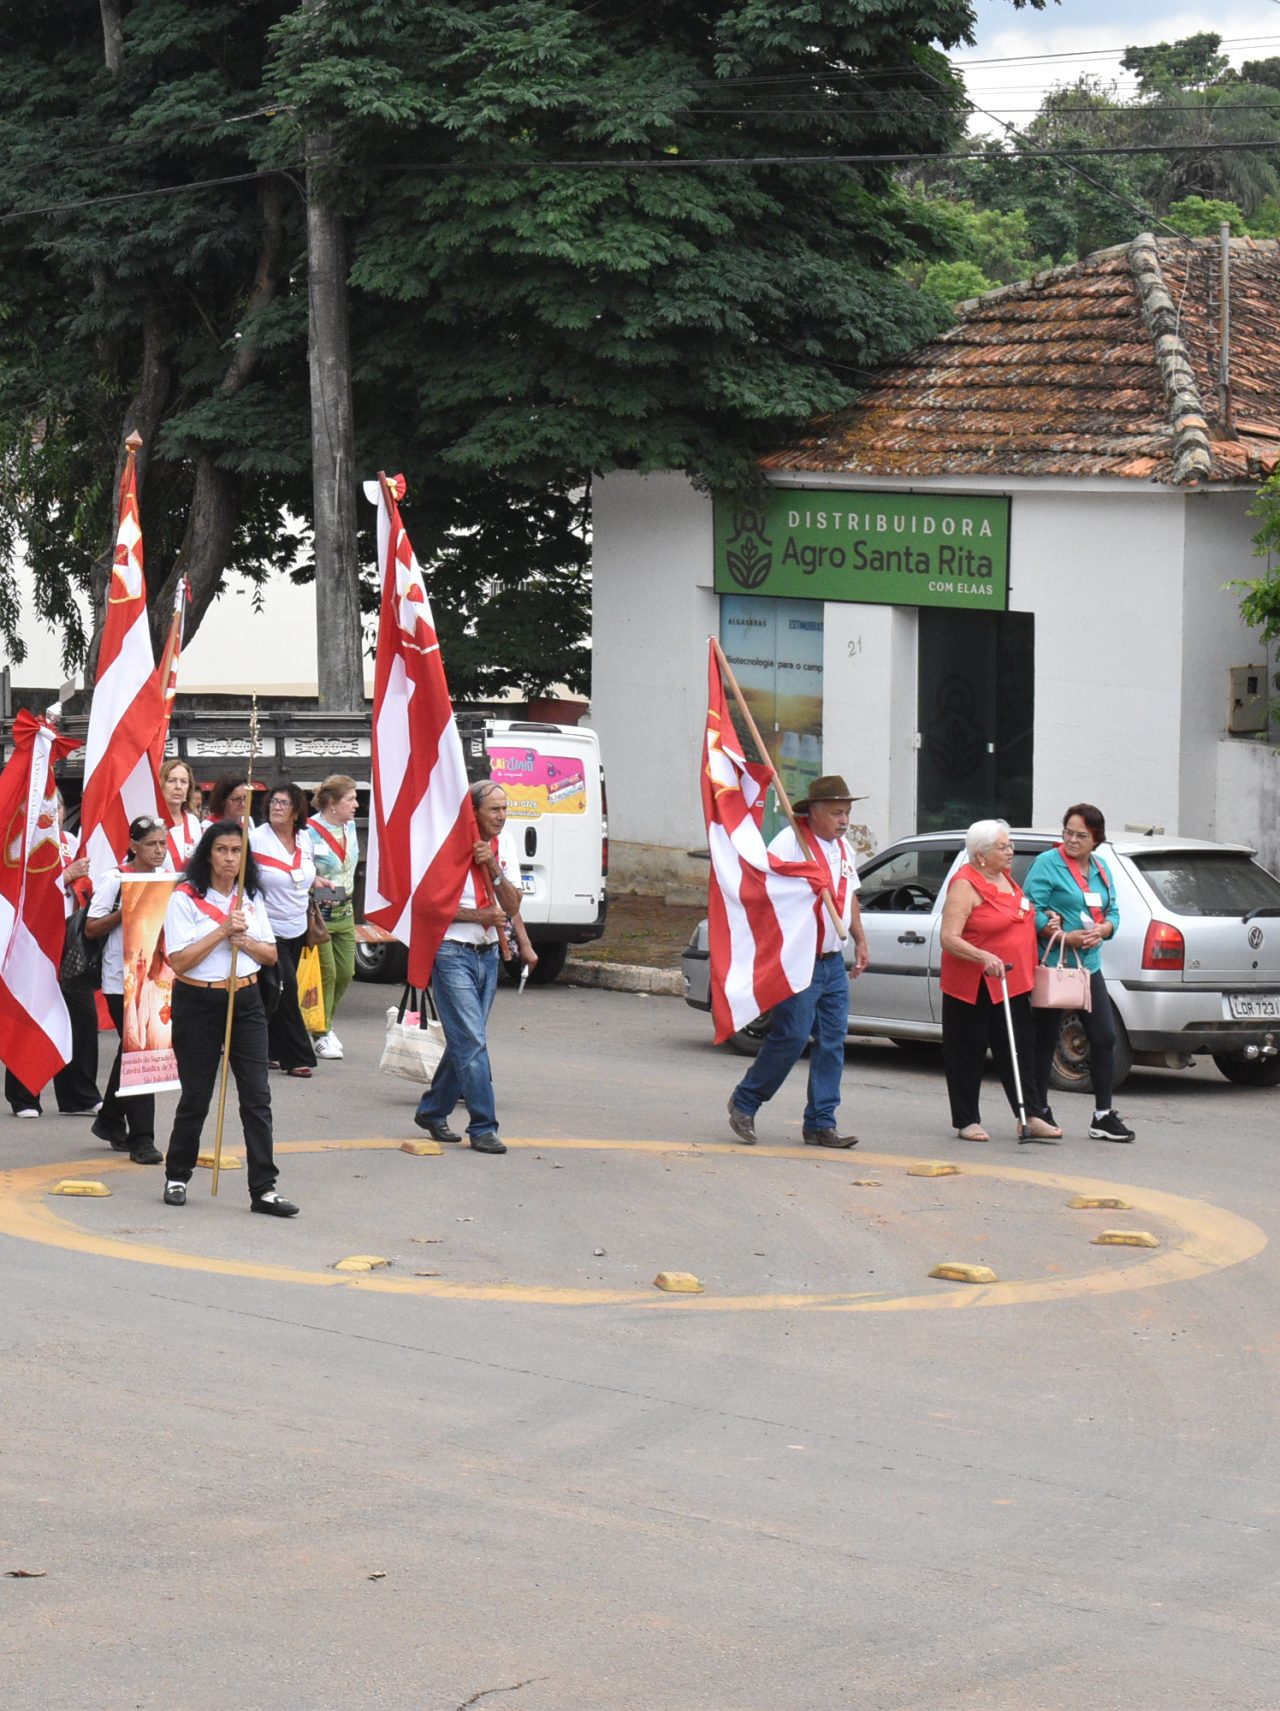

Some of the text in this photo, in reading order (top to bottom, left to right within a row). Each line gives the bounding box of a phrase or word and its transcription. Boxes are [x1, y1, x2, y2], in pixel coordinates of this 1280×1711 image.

[788, 511, 992, 537] DISTRIBUIDORA
[782, 535, 993, 578] Agro Santa Rita
[928, 580, 993, 596] COM ELAAS
[847, 635, 862, 658] 21
[777, 661, 794, 670] para
[803, 662, 824, 674] camp
